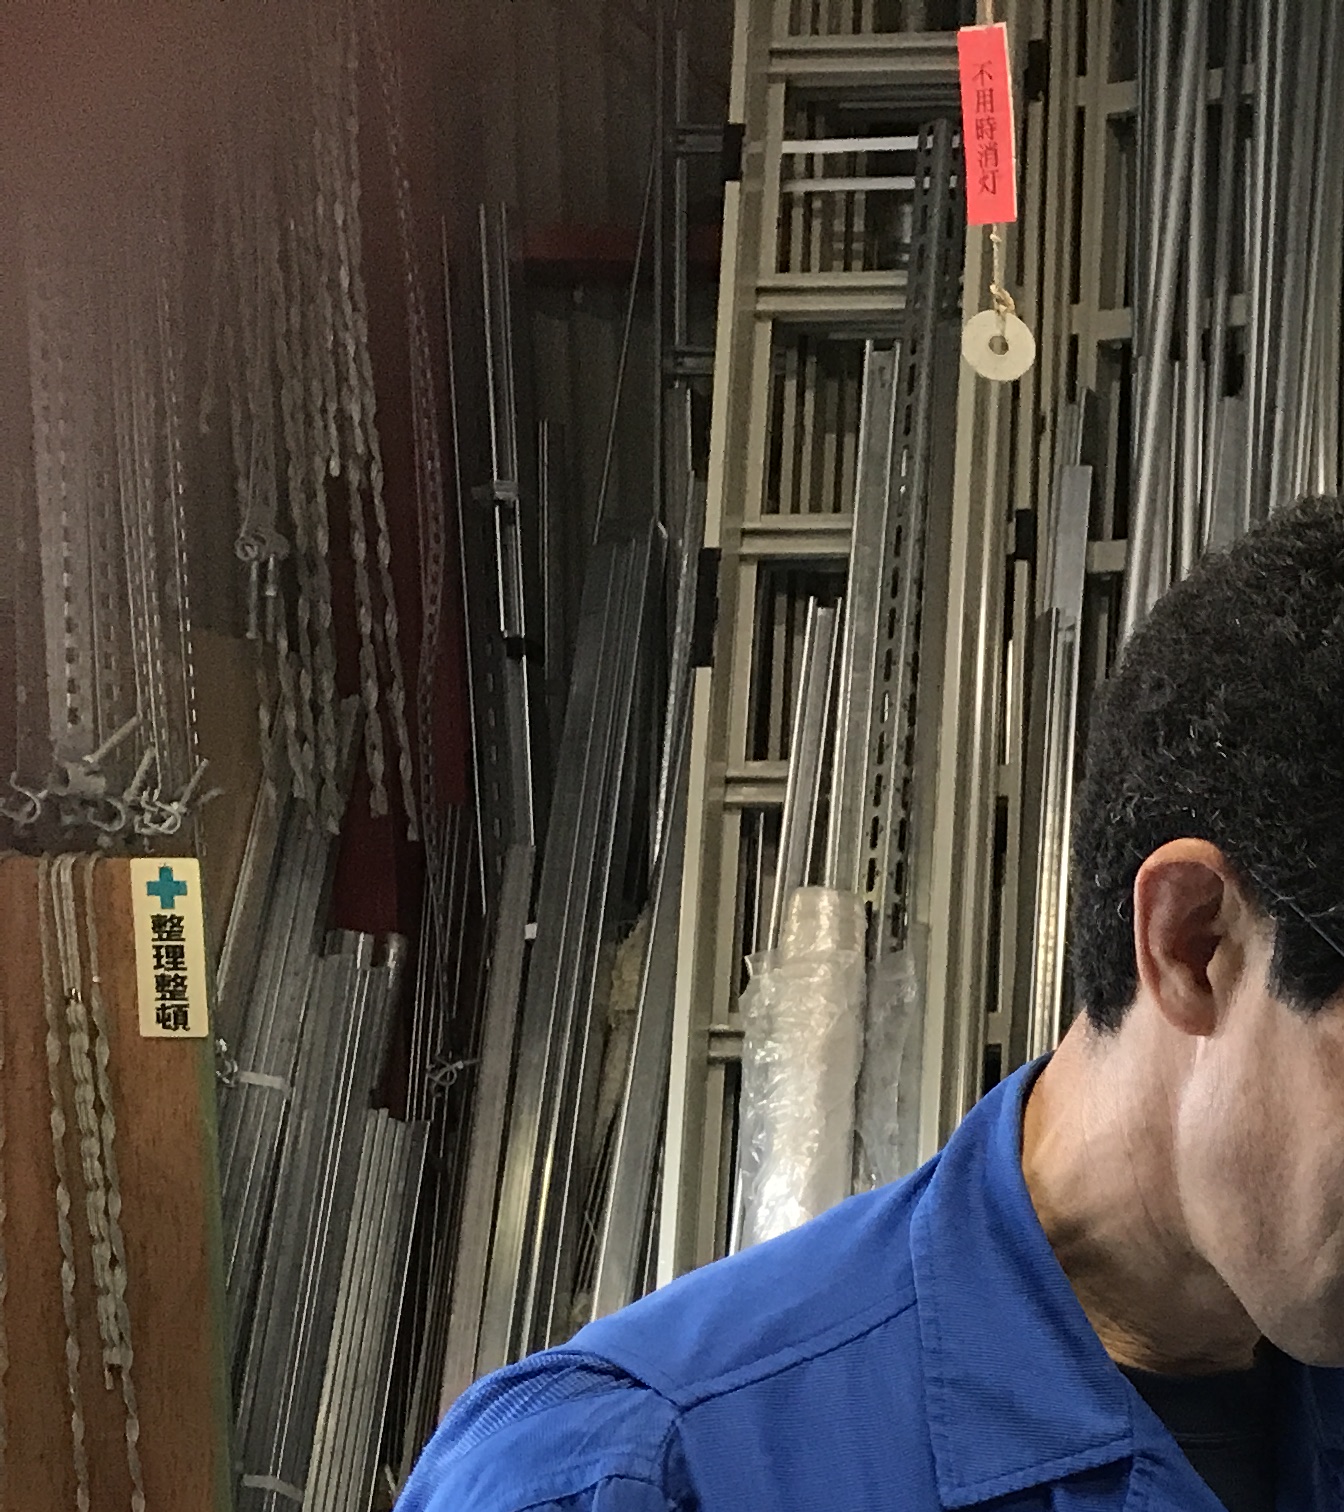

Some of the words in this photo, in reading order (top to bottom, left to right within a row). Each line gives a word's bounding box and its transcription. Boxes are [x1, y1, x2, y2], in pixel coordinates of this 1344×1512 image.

[971, 60, 1000, 195] 不用時消灯
[151, 914, 190, 1031] 整理整頓
